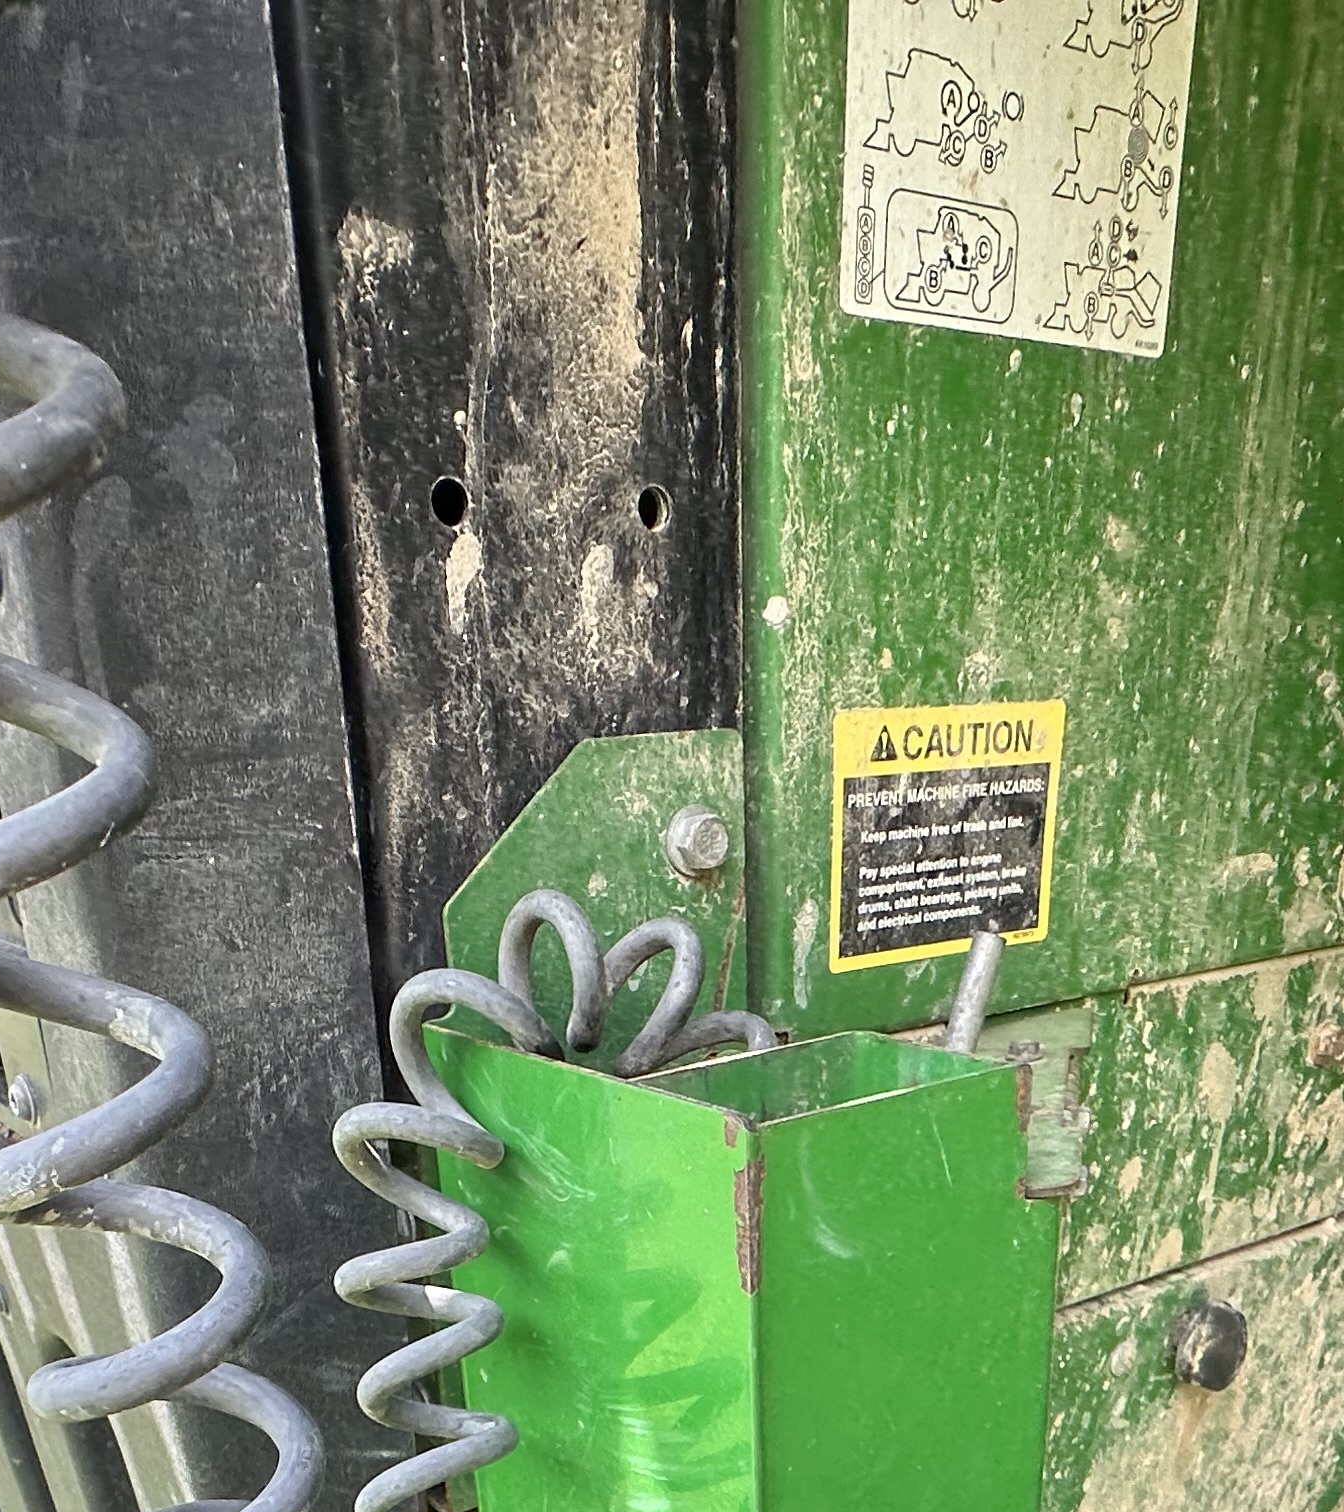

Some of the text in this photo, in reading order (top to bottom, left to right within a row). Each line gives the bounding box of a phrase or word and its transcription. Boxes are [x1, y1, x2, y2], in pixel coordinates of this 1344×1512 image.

[903, 719, 1034, 761] CAUTION
[847, 777, 1045, 809] PREVENT MACHINE FIRE HAZARDS:
[861, 816, 1025, 844] Keep machine free of trash and lint.
[858, 865, 1027, 898] compartment, exhaust system, brake
[859, 852, 1002, 880] Pay special attention to engine
[857, 882, 1024, 915] drums, shaft bearings, picking units,
[856, 905, 983, 933] and electrical components.
